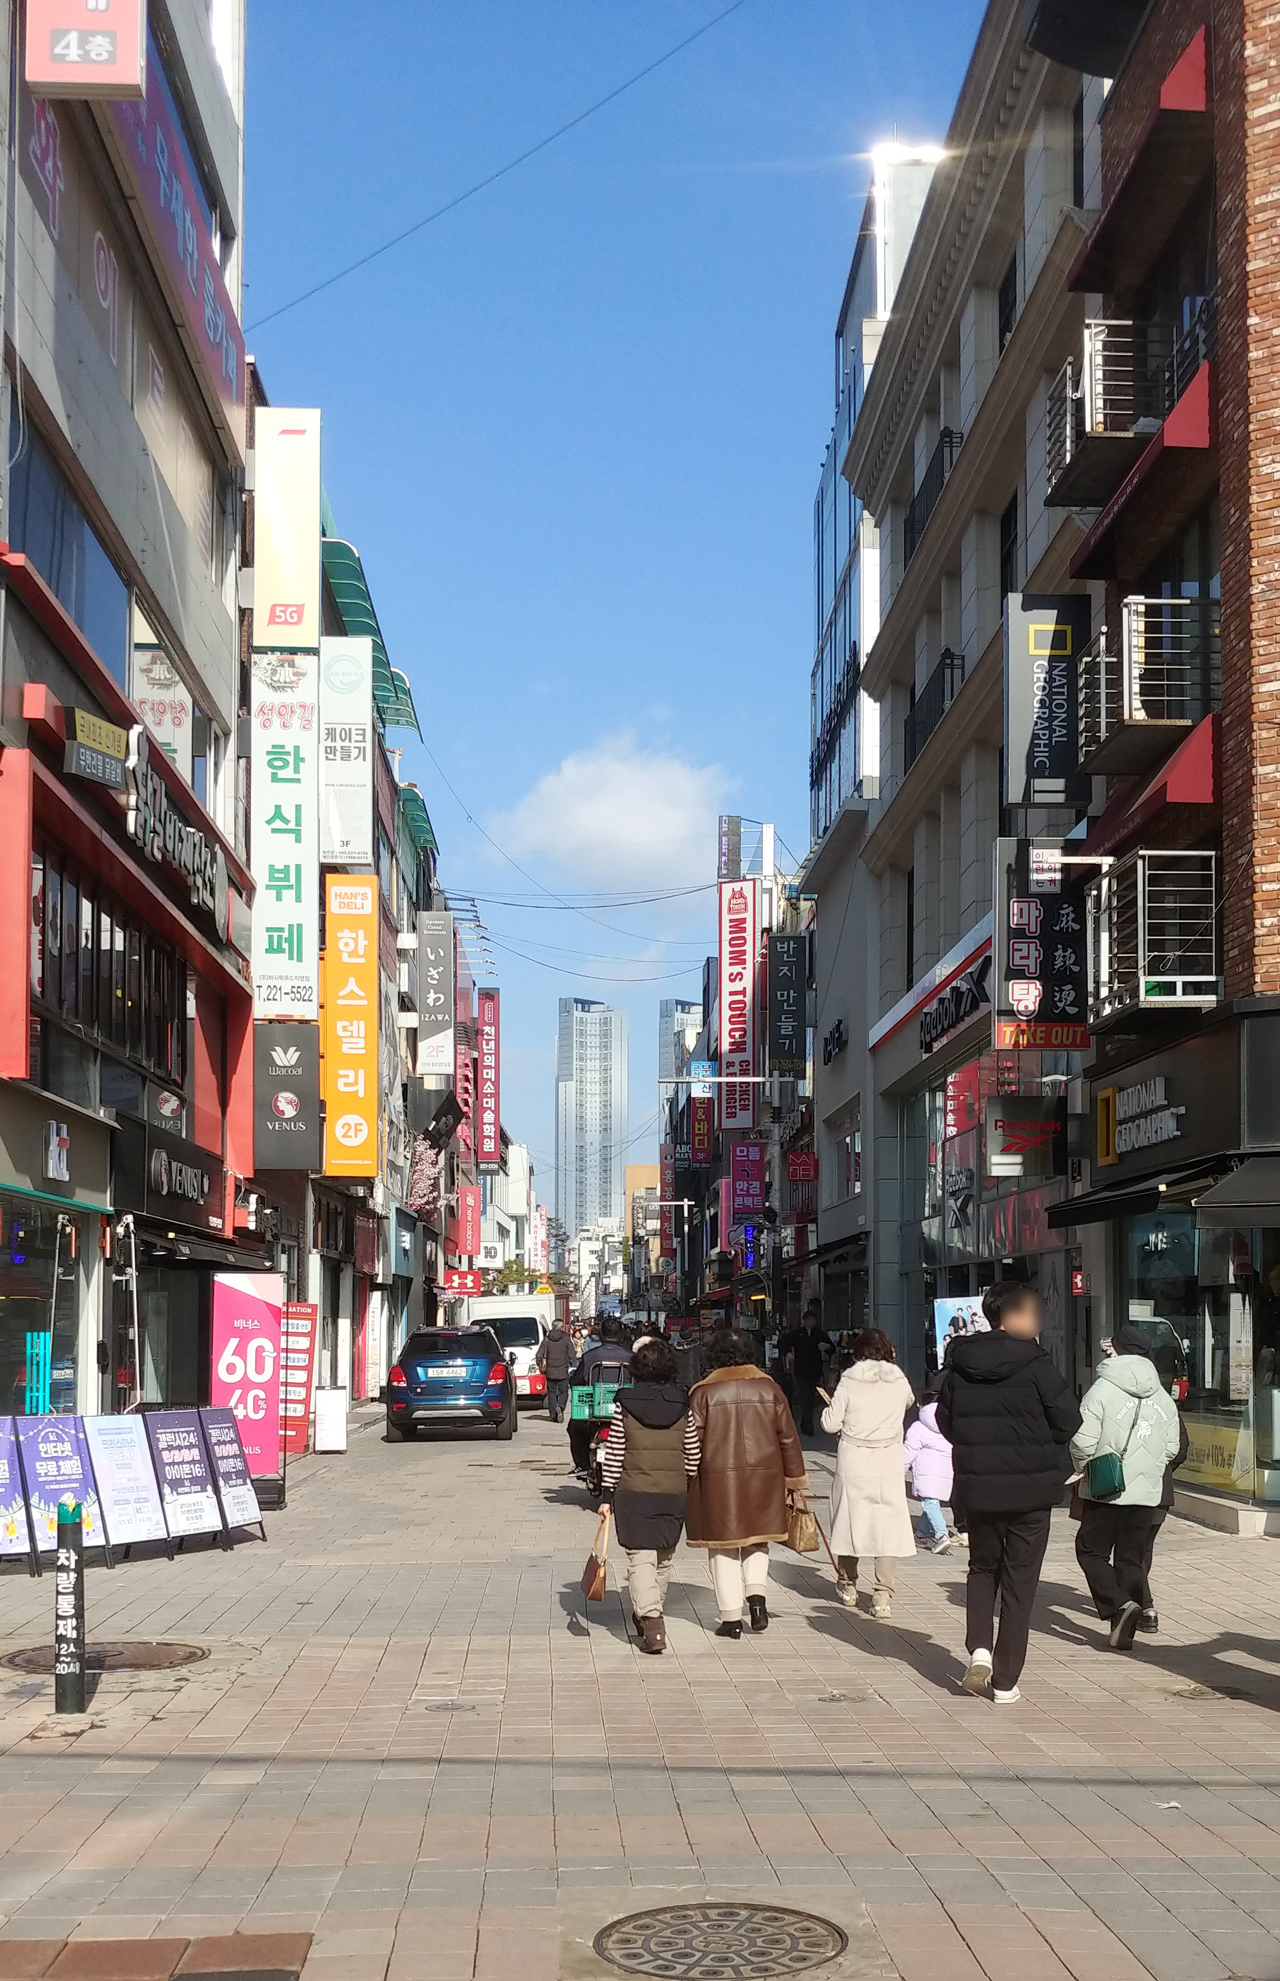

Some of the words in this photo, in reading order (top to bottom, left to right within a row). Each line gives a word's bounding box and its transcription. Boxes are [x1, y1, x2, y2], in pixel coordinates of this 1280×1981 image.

[53, 30, 114, 62] 4층
[275, 608, 299, 623] 5G
[1052, 662, 1068, 746] NATIONAL
[255, 701, 316, 731] 성안길
[1033, 660, 1050, 769] GEOGRAPHIC
[324, 727, 367, 744] 케이크
[324, 745, 367, 762] 만들기
[339, 840, 351, 848] 3F
[264, 744, 305, 963] 한식뷔페
[334, 891, 369, 901] HAN'S
[338, 901, 365, 911] DELI
[728, 917, 748, 983] MOM'S
[1010, 899, 1043, 1020] 마라탕
[426, 947, 445, 1007] いざわ
[256, 984, 313, 1002] T.221-5522
[336, 928, 368, 1098] 한스델리
[728, 986, 747, 1054] TOUCH
[1003, 1026, 1047, 1045] TAKE
[1051, 1026, 1084, 1045] OUT
[426, 1045, 446, 1058] 2F
[268, 1067, 303, 1076] Wacoal
[739, 1059, 751, 1112] CHCKEN
[1116, 1077, 1168, 1121] NATIONAL
[266, 1121, 306, 1131] VENUS
[341, 1122, 363, 1138] 2F
[994, 1118, 1062, 1134] Reebok
[1115, 1106, 1182, 1154] GEOGRAPHIC
[675, 1144, 692, 1153] ABC
[697, 1152, 706, 1160] 3F
[736, 1181, 760, 1195] 안경
[234, 1318, 261, 1330] 비너스
[38, 1442, 74, 1458] 인터넷
[156, 1432, 196, 1451] 갤럭시24
[35, 1461, 58, 1476] 무료
[60, 1459, 82, 1475] 체험
[165, 1463, 202, 1480] 아이폰16
[56, 1549, 79, 1639] 차량통제
[56, 1662, 80, 1675] 20시
